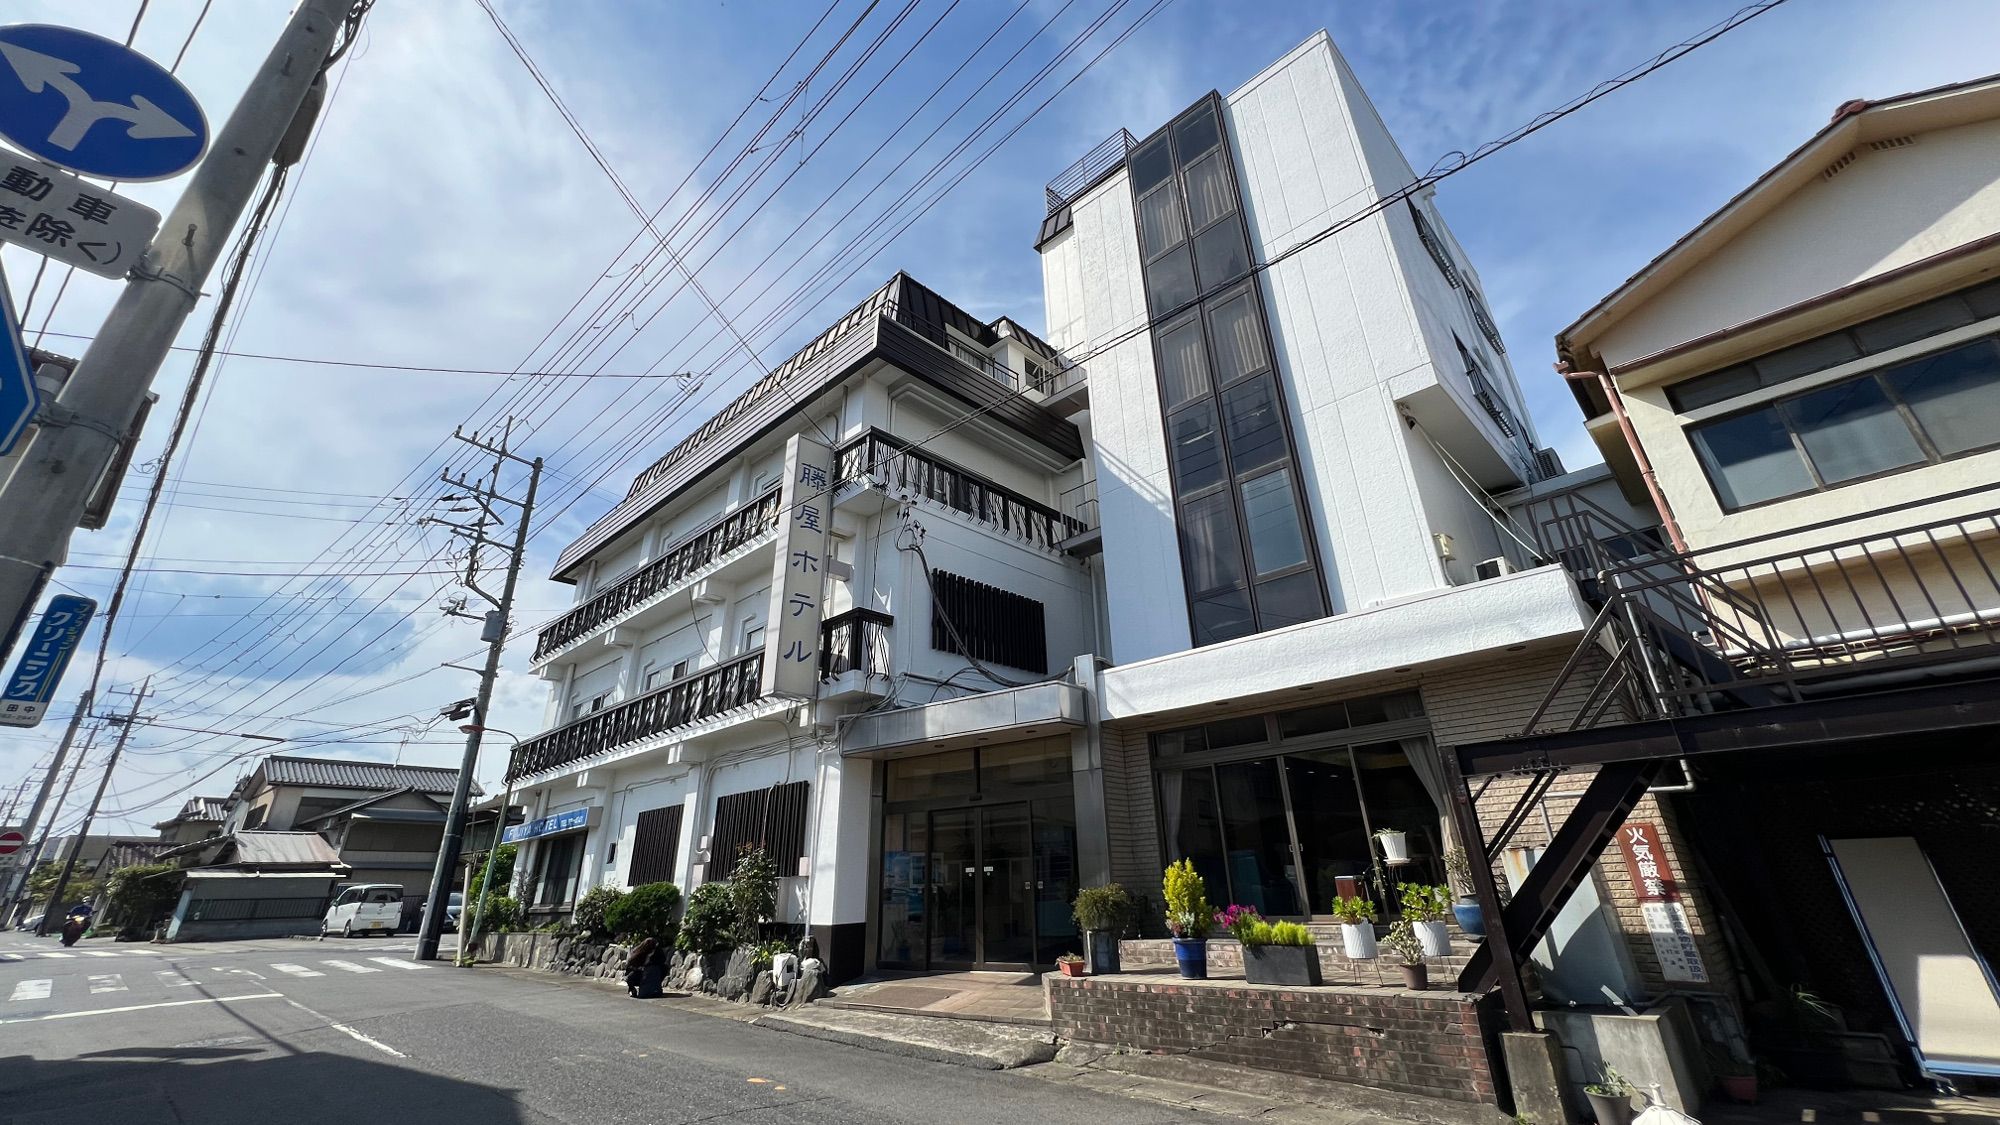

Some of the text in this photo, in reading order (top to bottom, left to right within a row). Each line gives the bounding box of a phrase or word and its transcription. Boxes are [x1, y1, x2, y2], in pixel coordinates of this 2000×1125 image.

[0, 165, 118, 225] 動車
[783, 462, 828, 663] 藤屋ホテル
[8, 611, 73, 698] クリーニング
[6, 703, 36, 713] 田中
[1625, 826, 1666, 896] 火気厳禁
